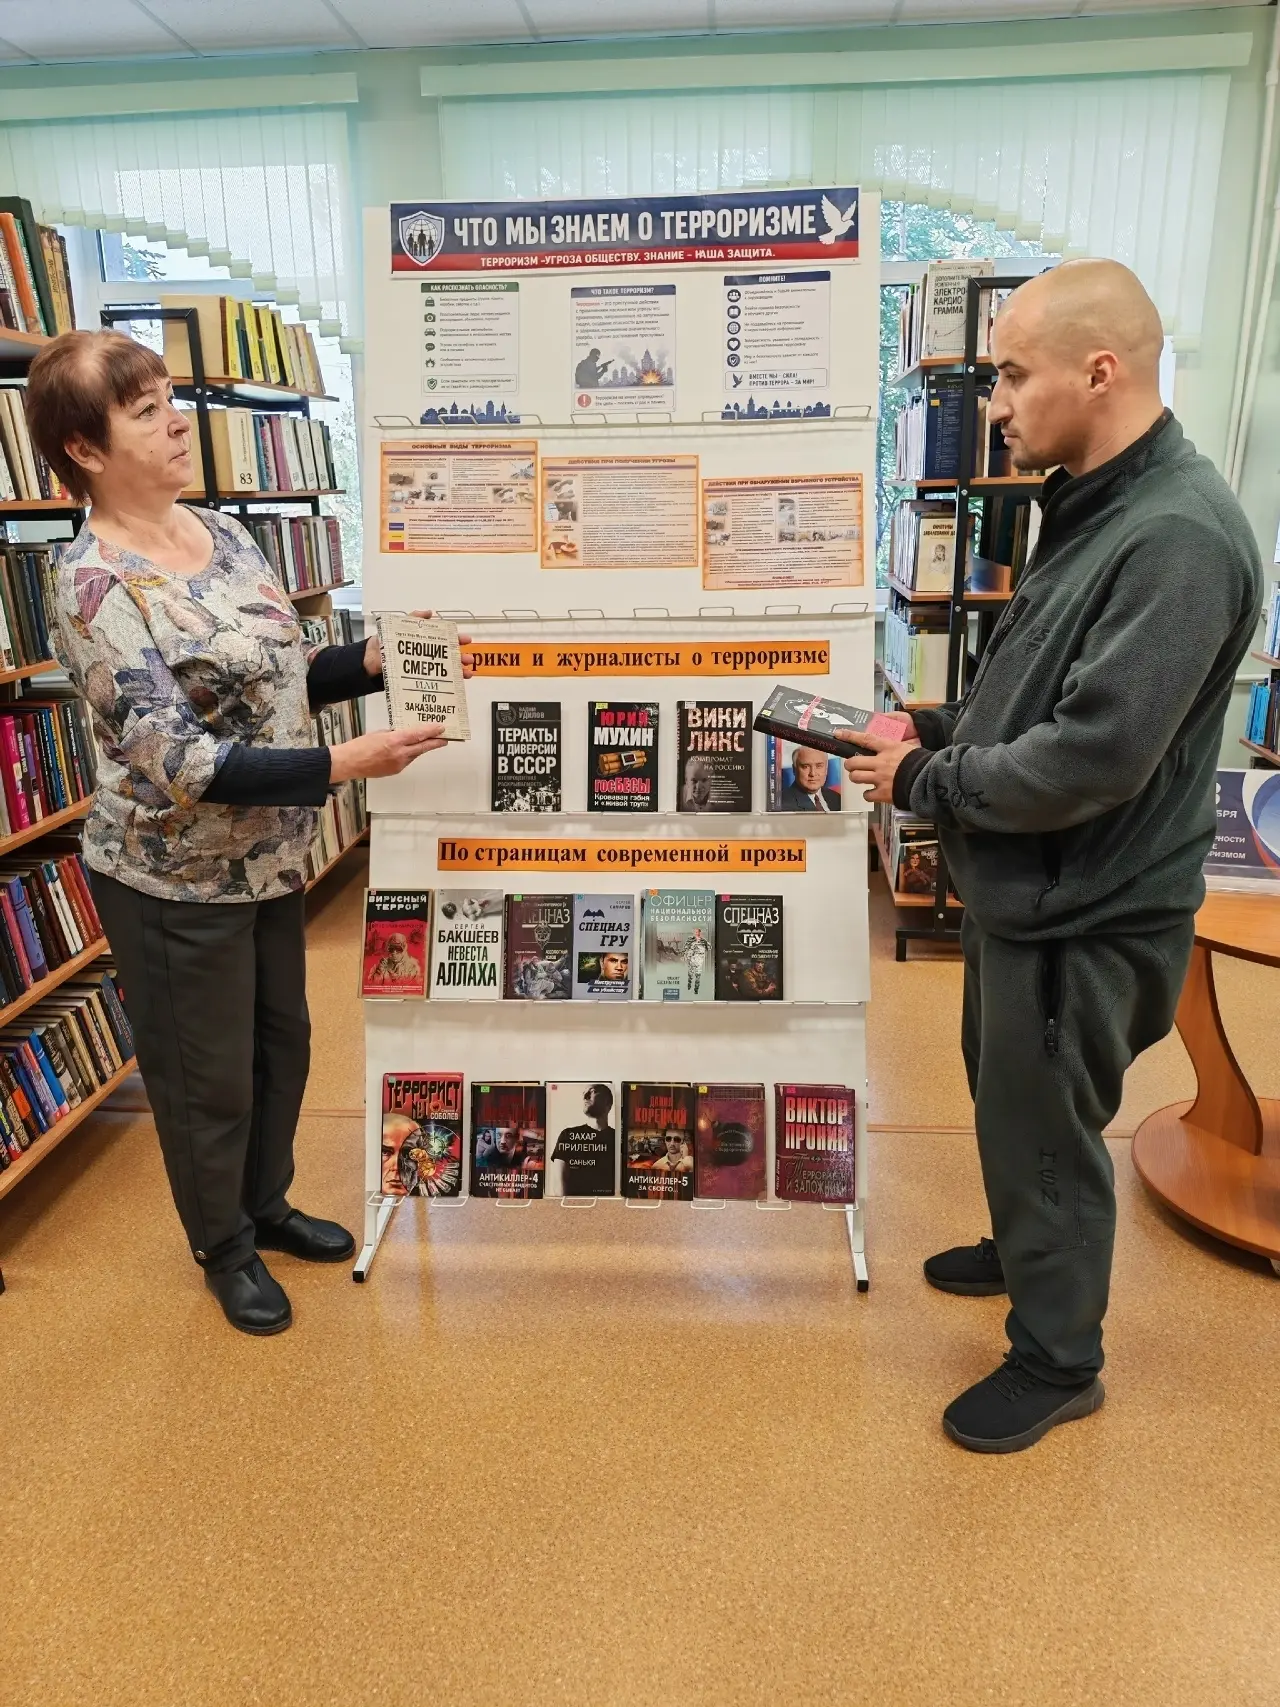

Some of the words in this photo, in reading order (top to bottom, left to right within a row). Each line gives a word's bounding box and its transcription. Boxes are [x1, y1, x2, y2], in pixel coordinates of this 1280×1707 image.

[453, 217, 497, 246] ЧТО
[505, 216, 546, 245] МЫ
[551, 213, 630, 244] ЗНАЕМ
[637, 212, 653, 240] О
[660, 204, 816, 240] ТЕРРОРИЗМЕ
[480, 255, 538, 267] ТЕРРОРИЗМ
[585, 252, 641, 264] ОБЩЕСТВУ.
[644, 250, 685, 261] ЗНАНИЕ
[727, 248, 776, 259] ЗАЩИТА.
[933, 306, 964, 315] ГРАММА
[239, 473, 253, 485] 83
[397, 640, 448, 660] СЕЮЩИЕ
[471, 652, 521, 671] рики
[532, 652, 544, 667] и
[557, 651, 680, 671] журналисты
[692, 652, 703, 666] о
[711, 649, 828, 670] терроризме
[403, 659, 448, 677] СМЕРТЬ
[415, 680, 439, 690] ИЛИ
[422, 694, 437, 703] КТО
[404, 702, 456, 714] ЗАКАЗЫВАЕТ
[417, 712, 447, 723] ТЕРРОР
[519, 712, 545, 720] УДИЛОВ
[687, 707, 747, 729] ВИКИ
[497, 728, 558, 743] ТЕРАКТЫ
[593, 726, 654, 747] МУХИН
[686, 730, 745, 752] ЛИКС
[497, 744, 505, 755] И
[507, 744, 557, 756] ДИВЕРСИИ
[497, 756, 509, 774] В
[513, 756, 557, 774] СССР
[594, 793, 628, 801] Кровавая
[1216, 810, 1238, 819] БРЯ
[1215, 835, 1246, 844] НОСТИ
[440, 842, 469, 861] По
[475, 845, 587, 867] страницам
[597, 844, 730, 868] современной
[740, 847, 804, 867] прозы
[1207, 851, 1246, 859] РИЗМОМ
[368, 894, 427, 903] ВИРУСНЫЙ
[650, 895, 712, 908] ОФИЦЕР
[375, 903, 420, 911] ТЕРРОР
[650, 907, 712, 915] НАЦИОНАЛЬНОЙ
[723, 907, 780, 925] СПЕЦНАЗ
[579, 922, 631, 933] СПЕЦНАЗ
[438, 930, 499, 944] БАКШЕЕВ
[600, 935, 629, 947] ГРУ
[743, 934, 764, 947] ГРУ
[447, 945, 488, 962] НЕВЕСТА
[436, 962, 497, 987] АЛЛАХА
[387, 1080, 461, 1112] ТЕРРОРИСТ
[430, 1112, 459, 1120] СОБОЛЕВ
[785, 1096, 848, 1125] ВИКТОР
[569, 1132, 597, 1141] ЗАХАР
[785, 1123, 848, 1152] ПРОНИН
[558, 1143, 608, 1152] ПРИЛЕПИН
[569, 1158, 596, 1166] САНЬКЯ
[479, 1173, 539, 1183] АНТИКИЛЛЕР-4
[628, 1175, 688, 1187] АНТИКИЛЛЕР-5
